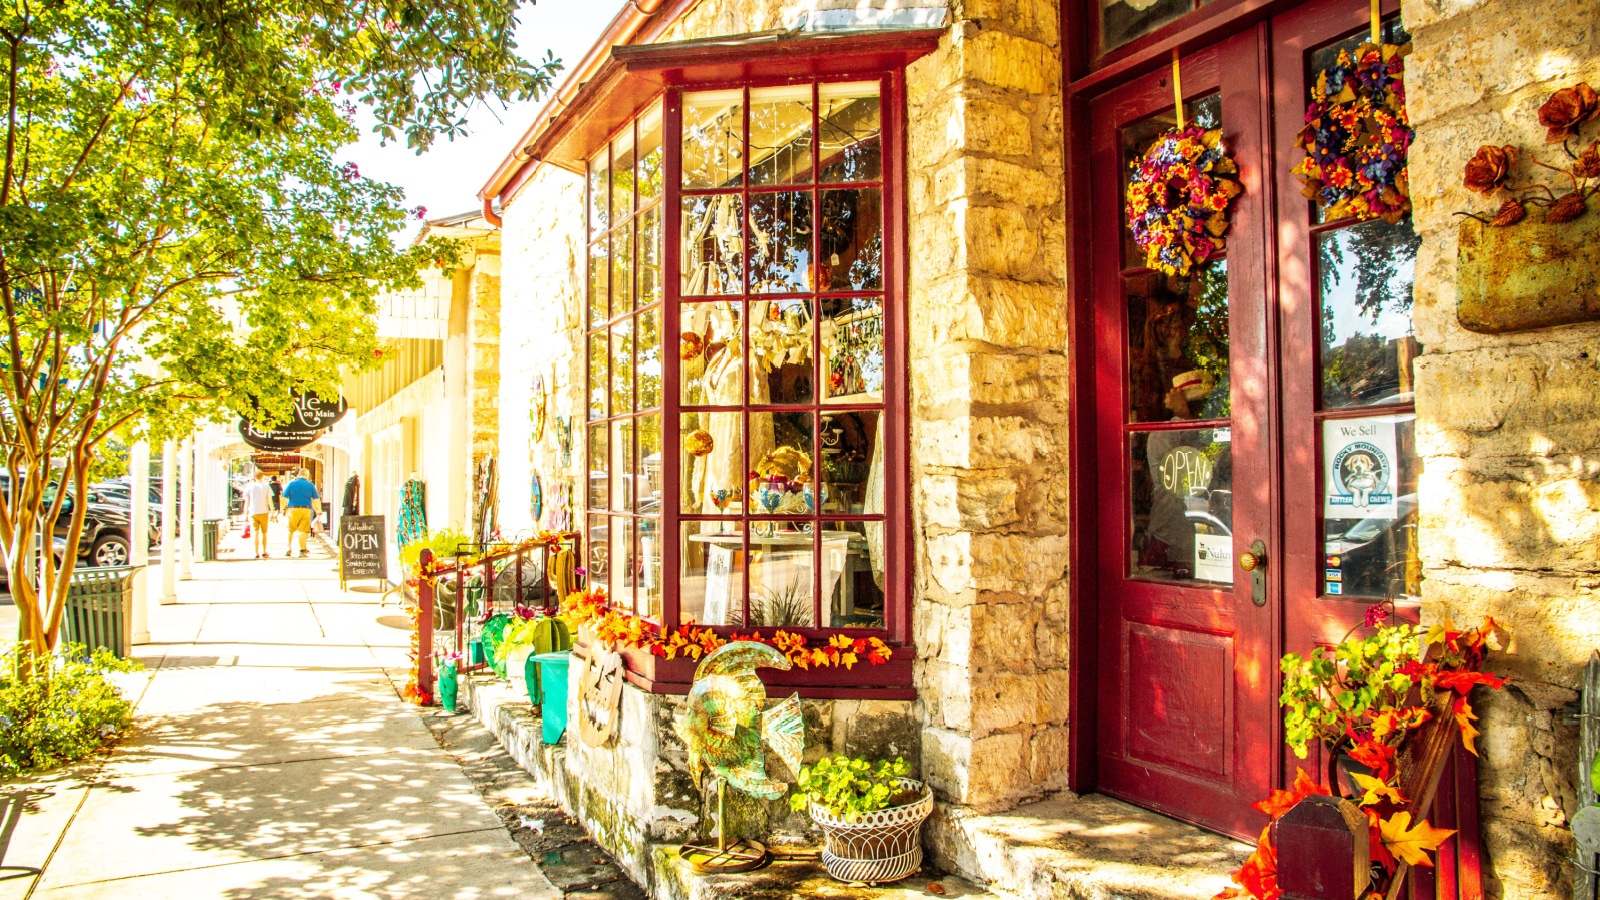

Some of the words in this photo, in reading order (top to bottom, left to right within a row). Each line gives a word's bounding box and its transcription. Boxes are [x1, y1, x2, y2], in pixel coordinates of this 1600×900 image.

[316, 410, 335, 418] Main
[1340, 427, 1356, 436] We
[1359, 425, 1376, 436] Sell
[1335, 447, 1352, 470] ROCKY
[1354, 444, 1387, 468] MOUNTAIN
[1163, 451, 1207, 495] OPEN
[344, 533, 379, 550] OPEN
